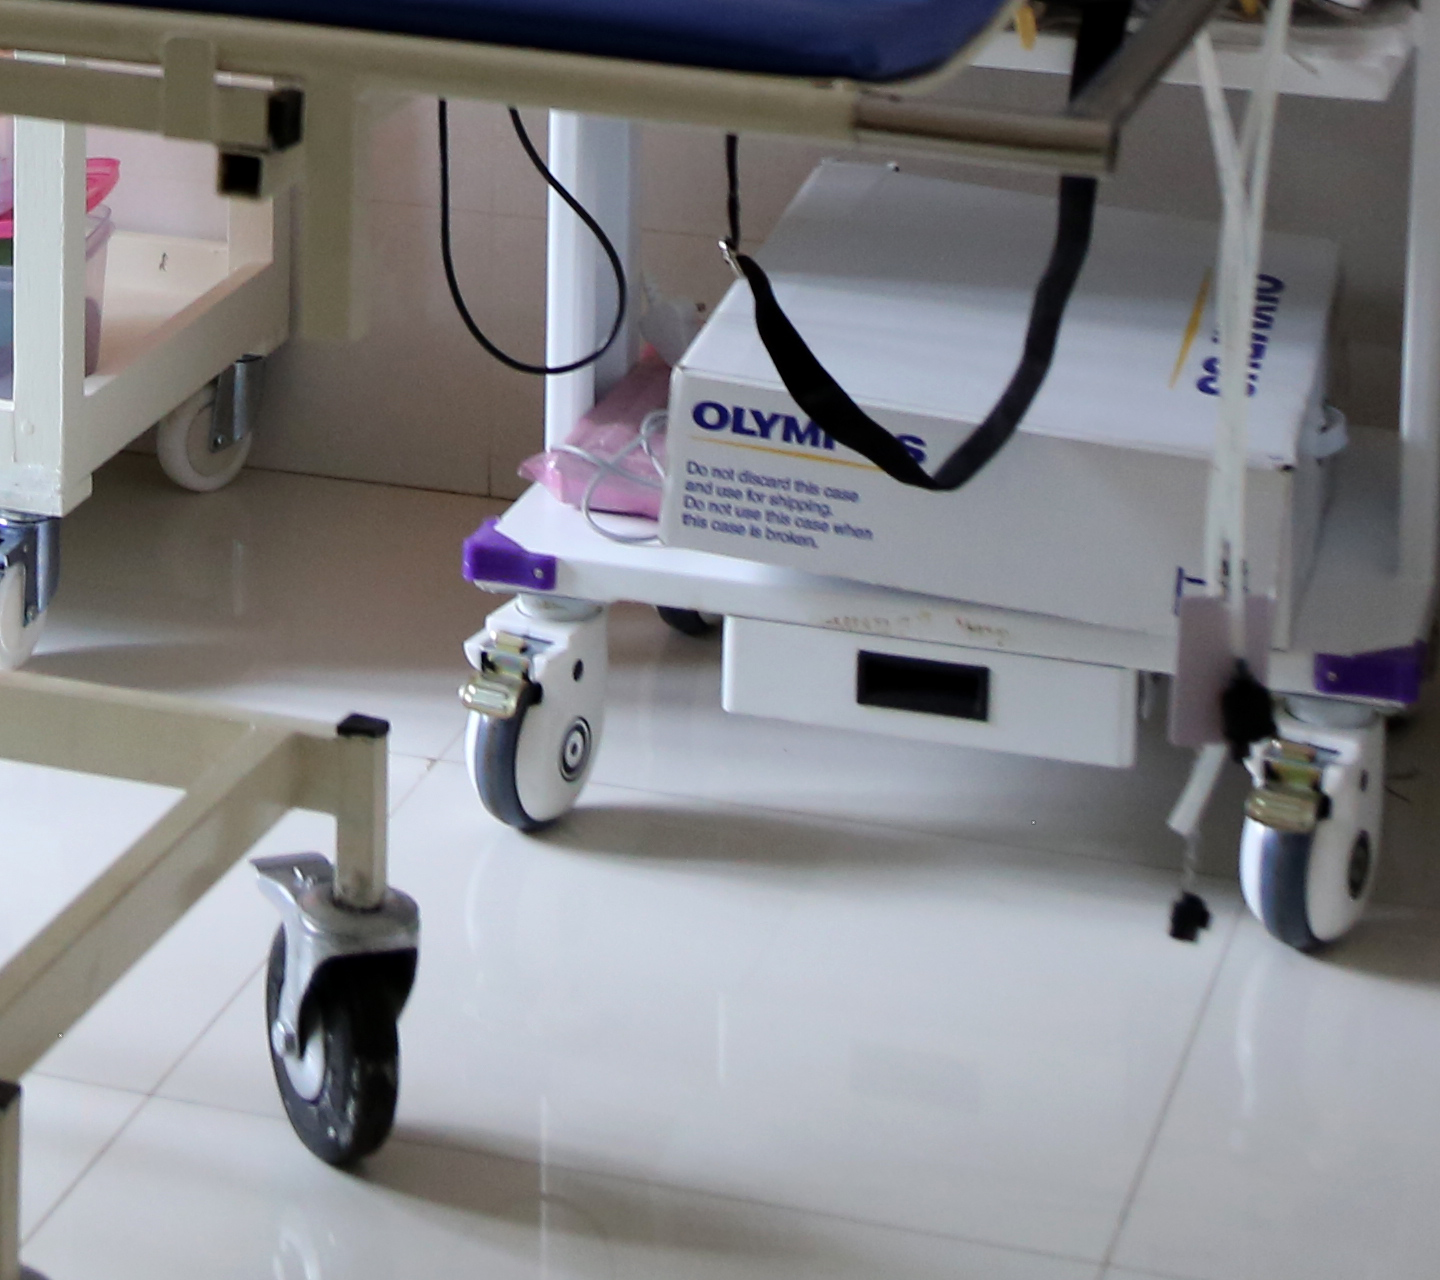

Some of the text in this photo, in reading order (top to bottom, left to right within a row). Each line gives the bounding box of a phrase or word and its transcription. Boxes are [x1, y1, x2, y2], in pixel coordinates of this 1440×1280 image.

[692, 400, 927, 465] OLYMS
[685, 479, 833, 518] and use for shipping.
[687, 460, 859, 503] Do not discard this case
[682, 513, 819, 549] this case is broken.
[684, 495, 873, 540] Do not use this case when
